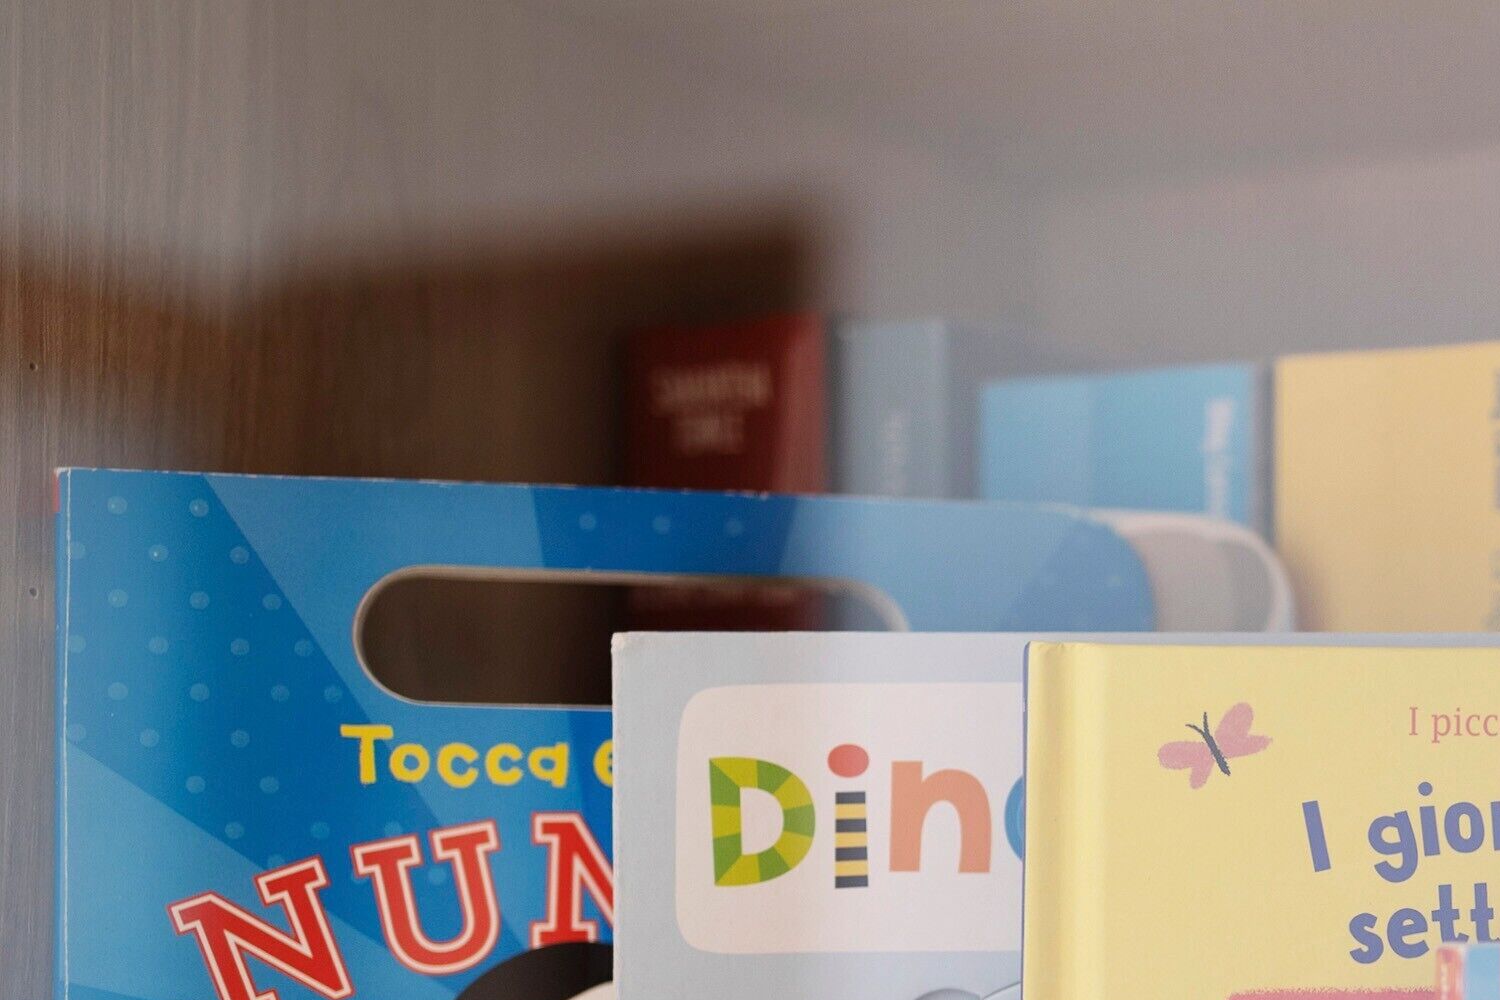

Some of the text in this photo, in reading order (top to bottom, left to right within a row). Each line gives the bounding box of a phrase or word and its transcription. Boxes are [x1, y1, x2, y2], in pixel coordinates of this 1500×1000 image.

[340, 723, 569, 789] Tocca
[1408, 706, 1419, 737] I
[708, 742, 1024, 890] Din
[1301, 800, 1331, 873] I
